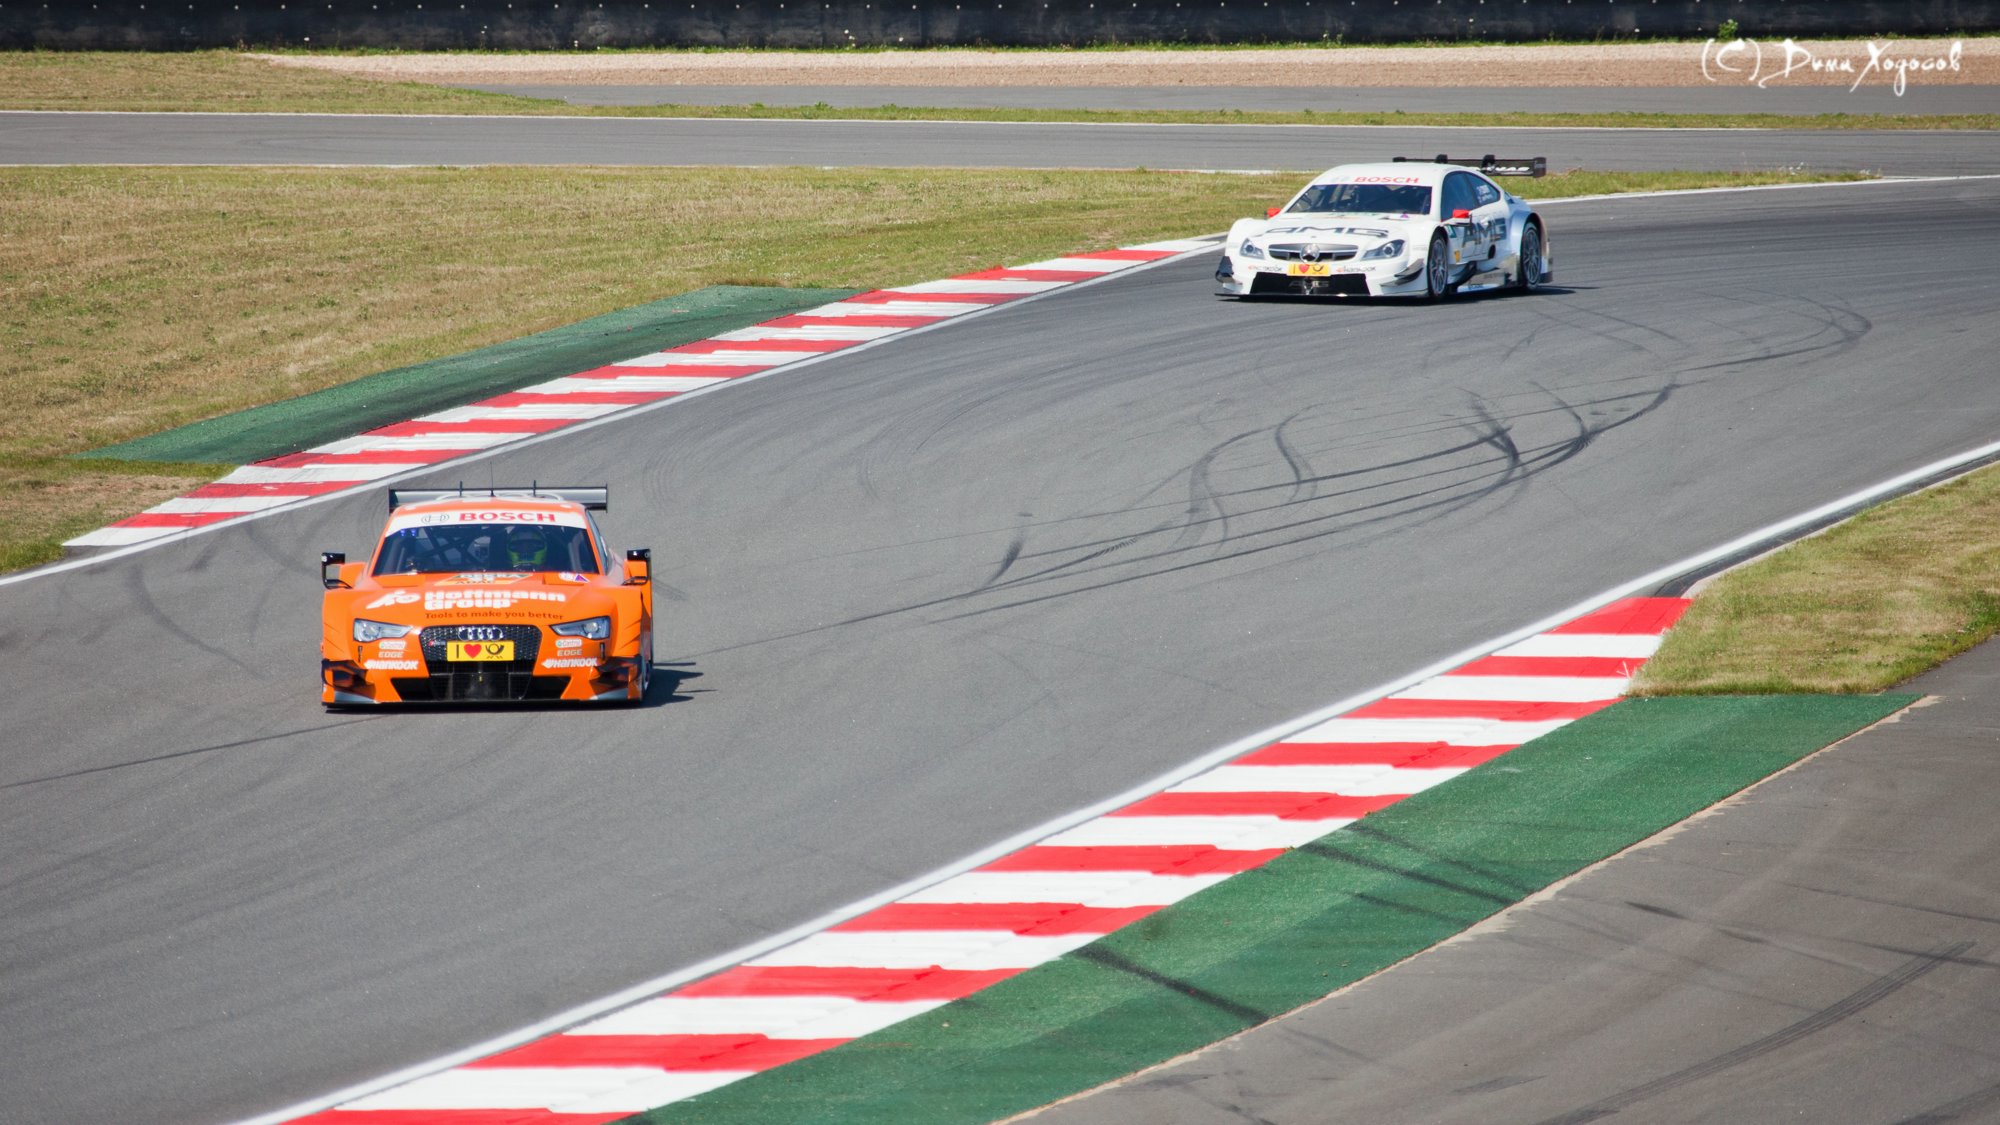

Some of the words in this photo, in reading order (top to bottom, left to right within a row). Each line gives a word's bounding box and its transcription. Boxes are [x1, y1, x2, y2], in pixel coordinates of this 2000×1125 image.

[1354, 176, 1420, 184] BOSCH
[1462, 217, 1507, 248] AMG
[459, 512, 556, 522] BOSCH
[424, 589, 566, 602] Hoffmann
[424, 598, 511, 611] Group
[471, 610, 502, 618] make
[504, 611, 525, 619] you
[528, 611, 563, 620] better
[557, 649, 582, 657] EDGE
